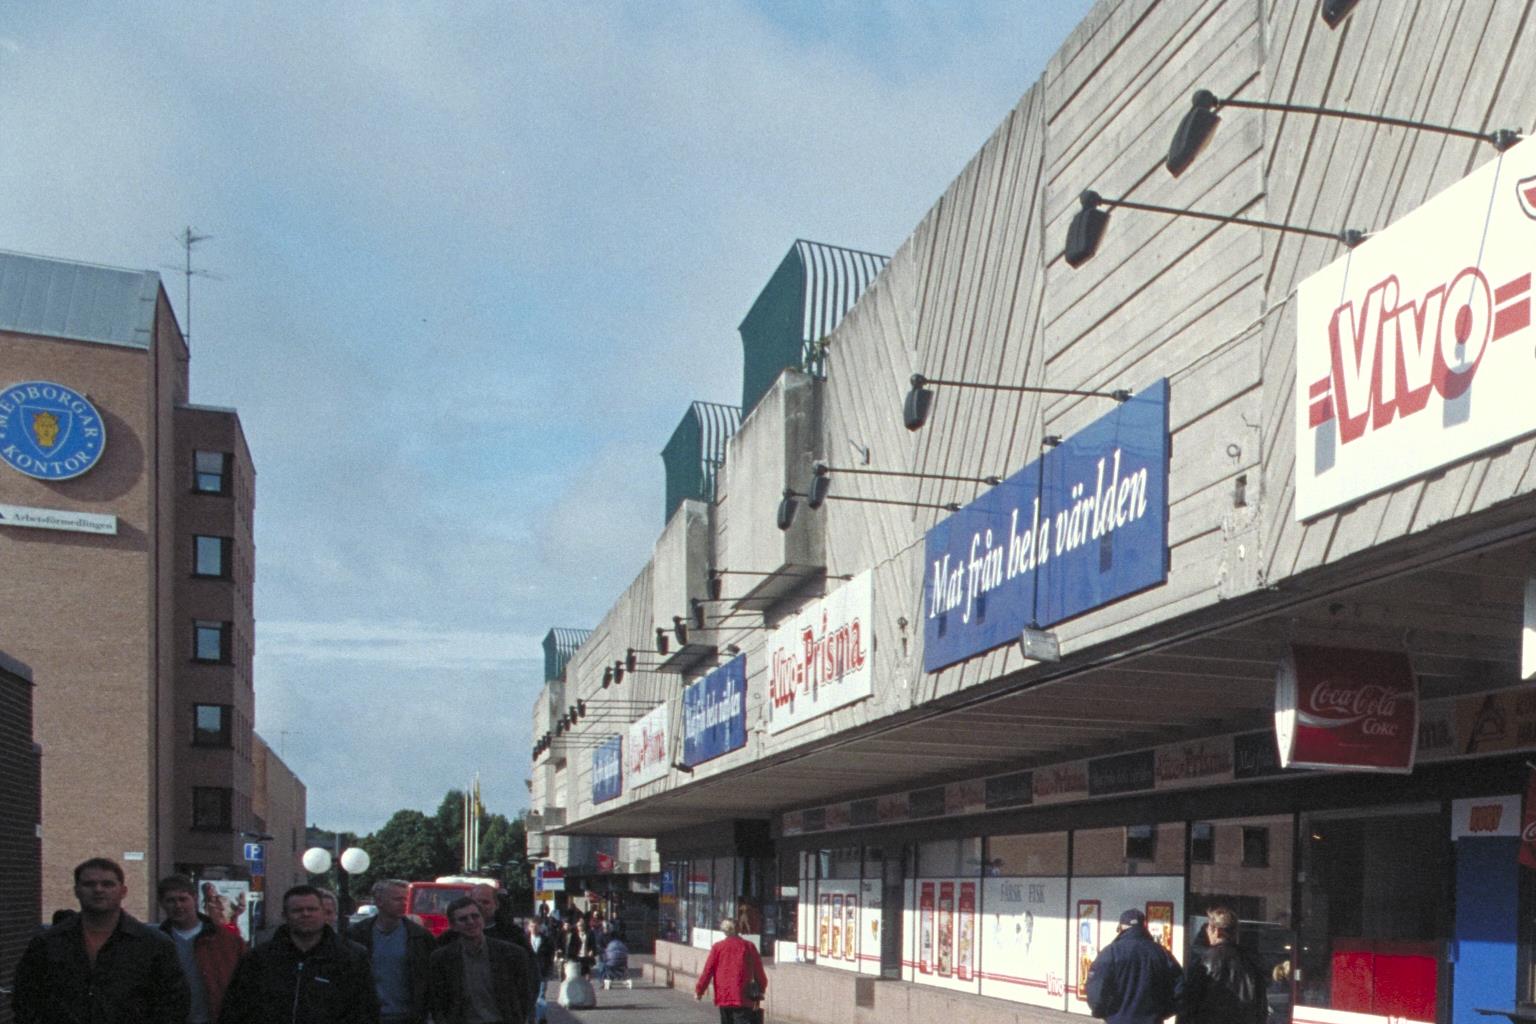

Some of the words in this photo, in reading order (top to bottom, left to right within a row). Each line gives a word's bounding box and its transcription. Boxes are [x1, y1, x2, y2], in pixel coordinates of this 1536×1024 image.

[1329, 267, 1495, 445] Vivo
[0, 386, 98, 438] MEDBORGAR
[4, 444, 91, 475] KONTOR
[929, 553, 964, 620] Mat
[963, 529, 1003, 624] från
[1007, 497, 1050, 580] hela
[1056, 449, 1148, 556] världen
[801, 608, 867, 696] Prisma
[1361, 717, 1399, 736] Coke
[251, 843, 261, 859] P
